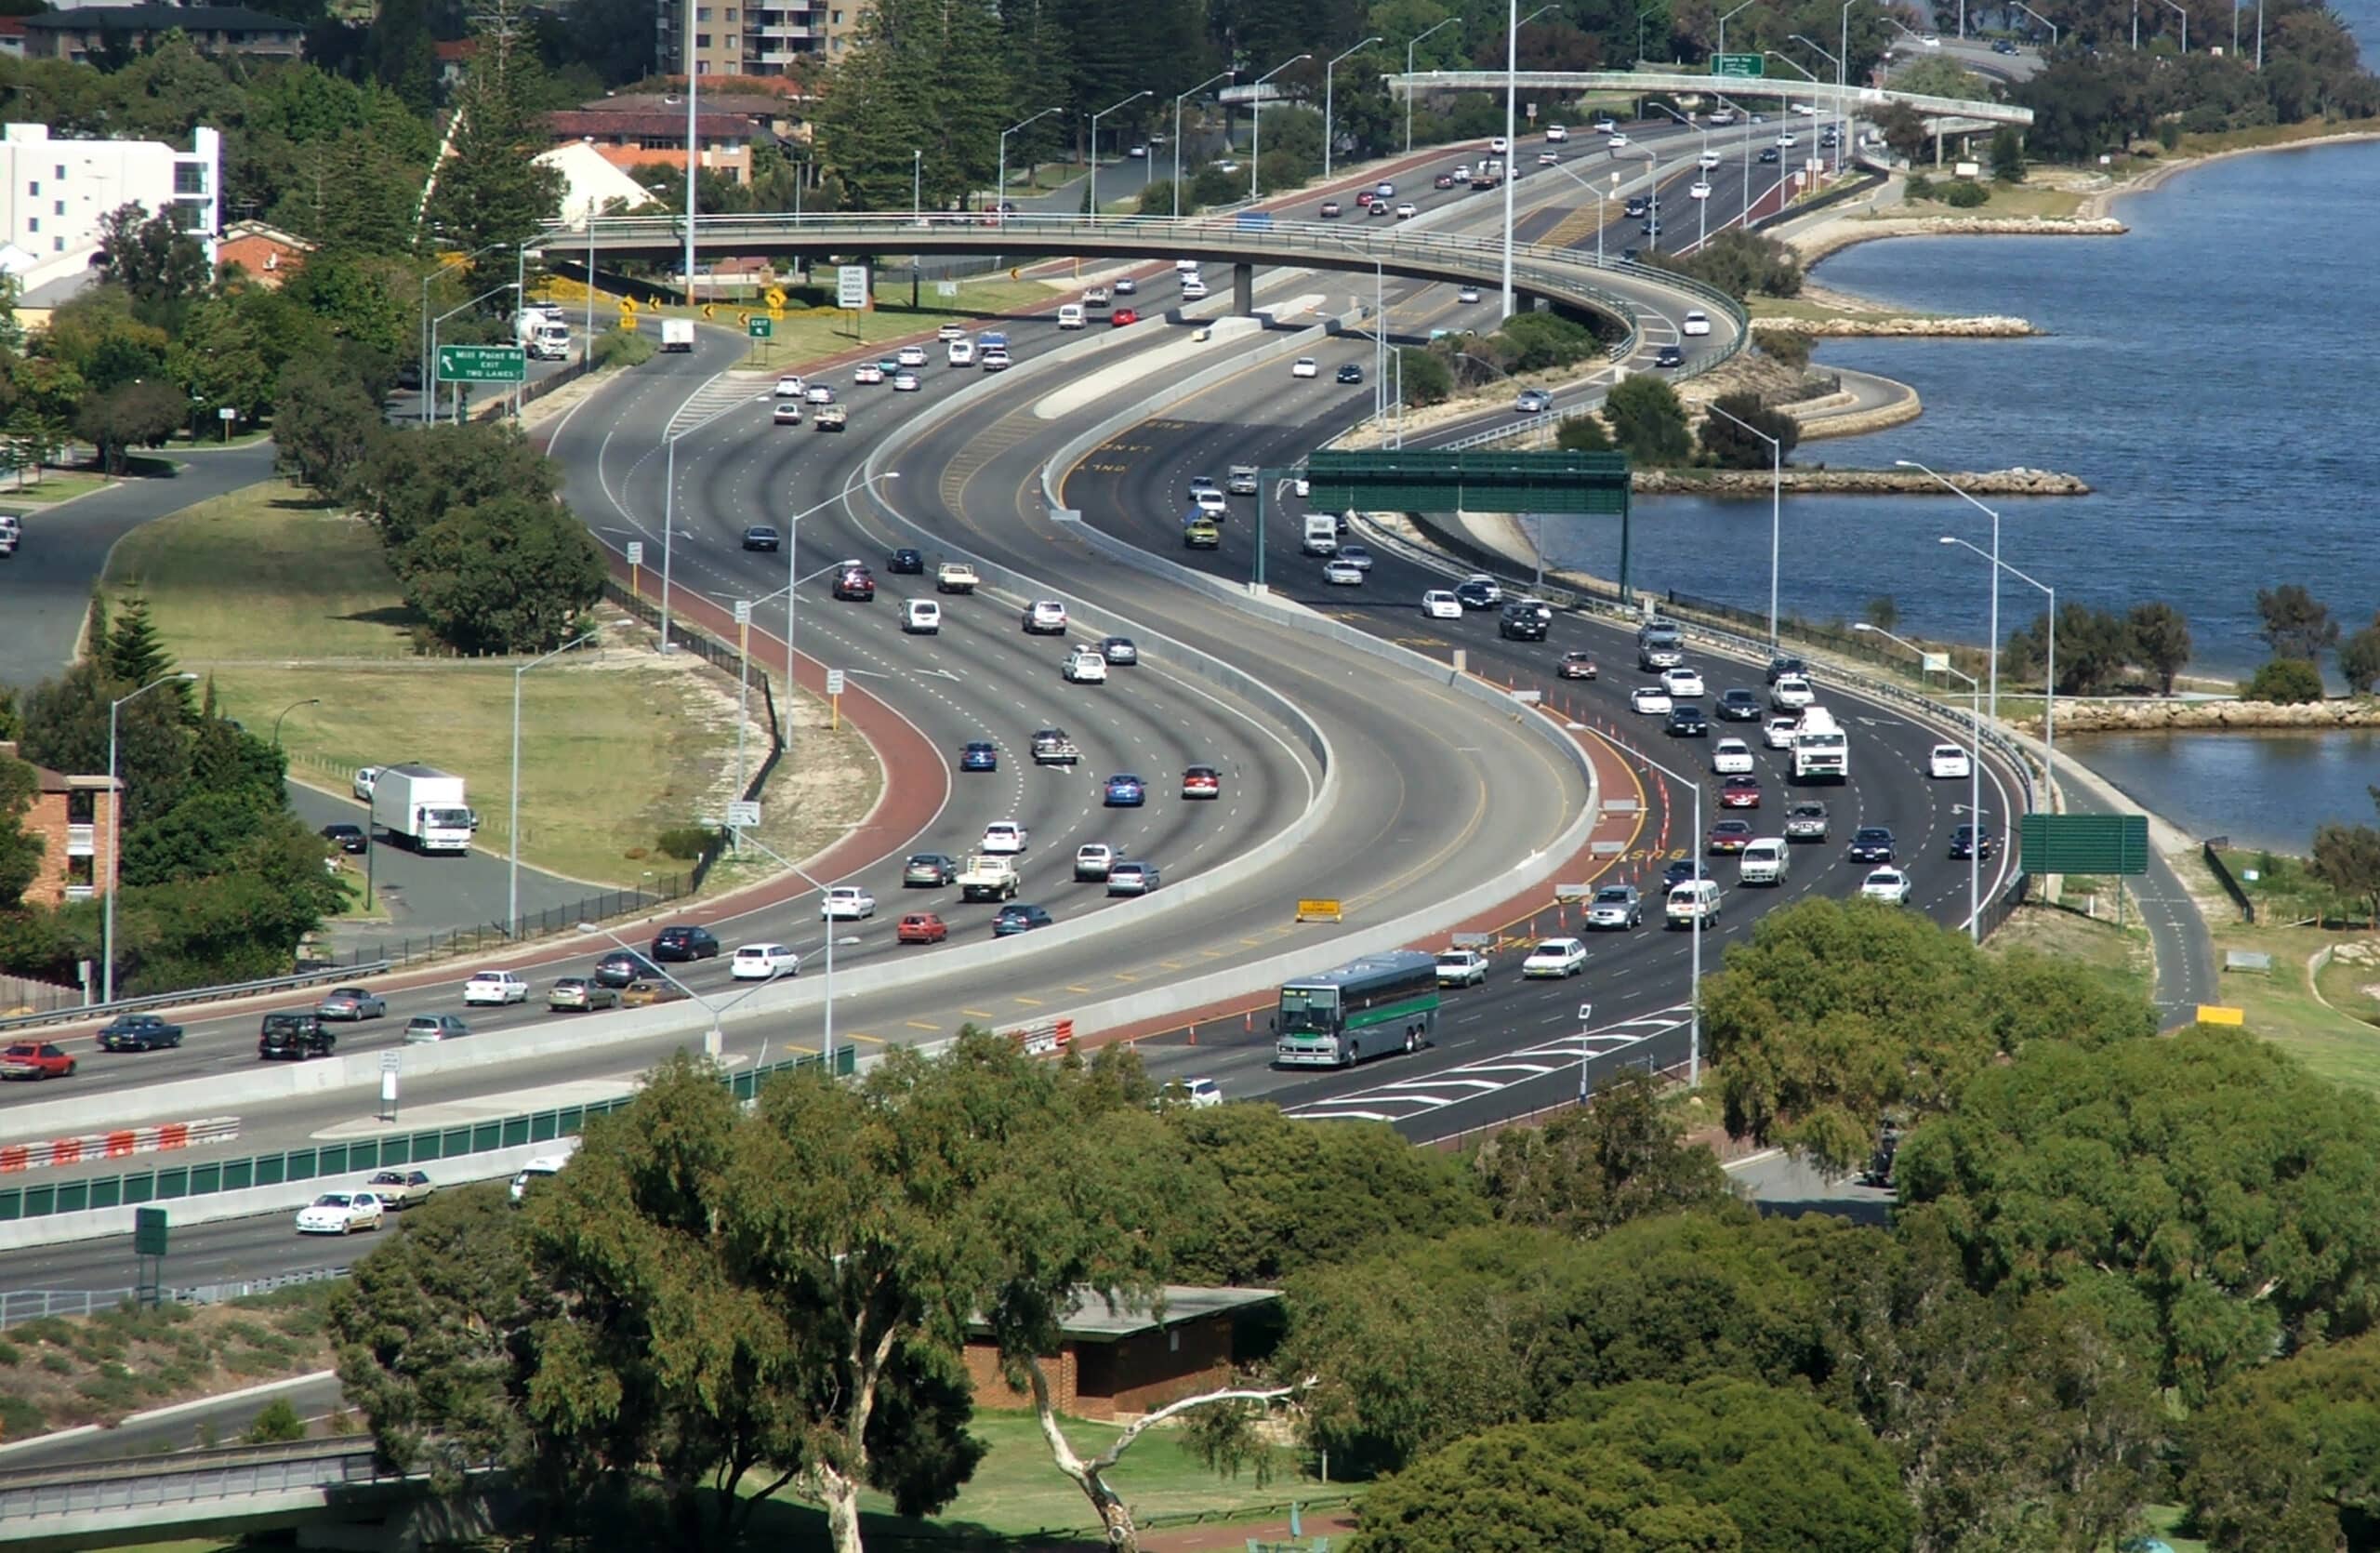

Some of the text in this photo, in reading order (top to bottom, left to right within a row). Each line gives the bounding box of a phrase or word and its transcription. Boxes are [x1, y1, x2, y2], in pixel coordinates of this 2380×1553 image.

[456, 351, 522, 360] Mill Point Rd
